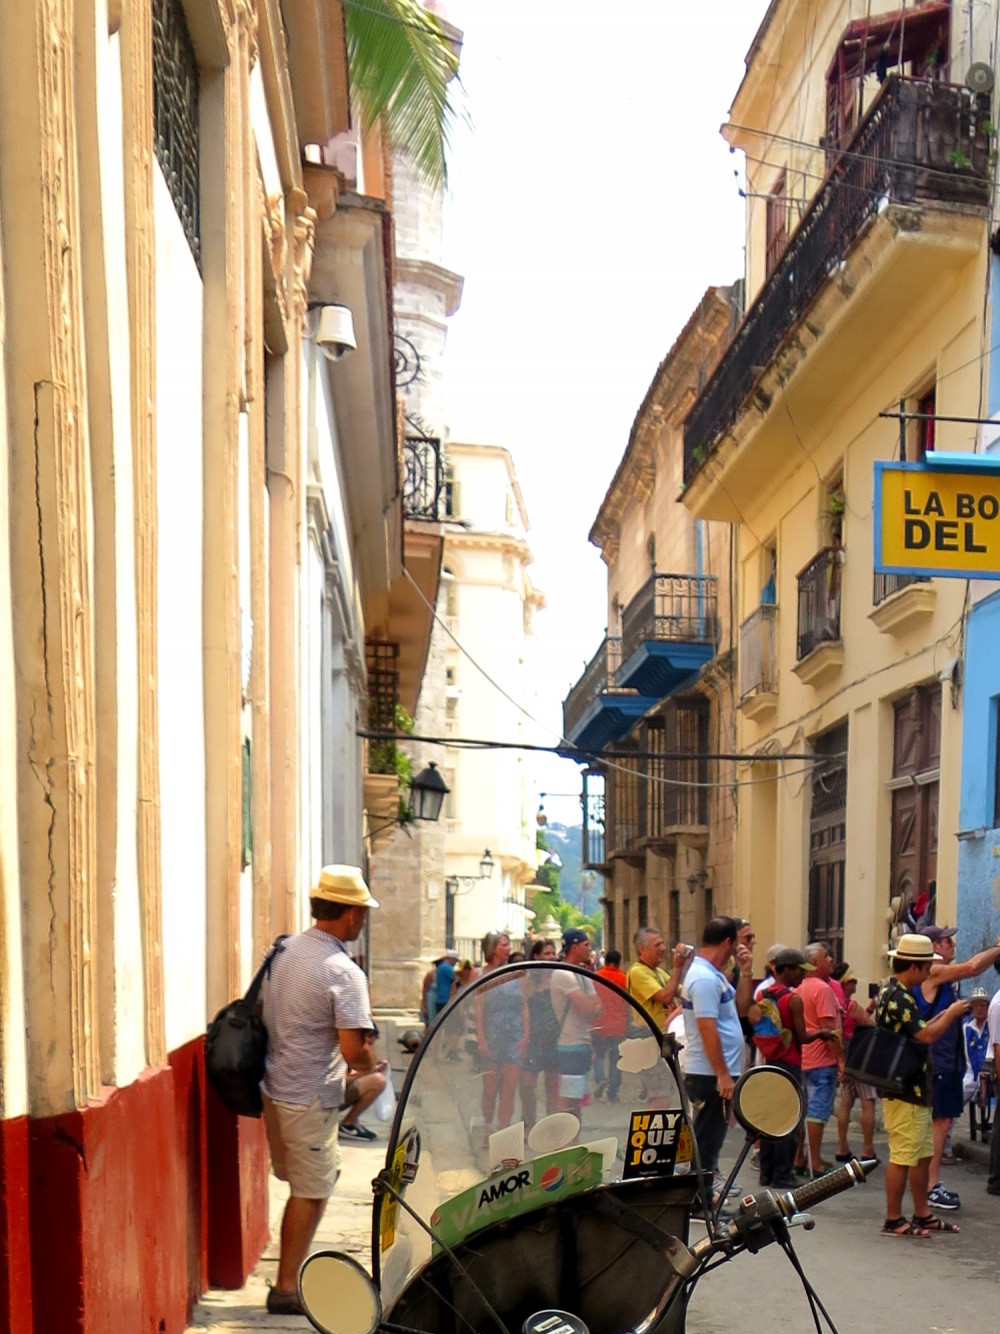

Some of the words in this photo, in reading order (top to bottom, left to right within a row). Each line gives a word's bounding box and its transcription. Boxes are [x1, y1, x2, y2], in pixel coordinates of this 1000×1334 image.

[904, 489, 945, 517] LA
[904, 518, 988, 553] DEL
[631, 1113, 681, 1132] HAY
[631, 1129, 677, 1149] QUE
[630, 1148, 671, 1166] JO...
[478, 1170, 531, 1209] AMOR
